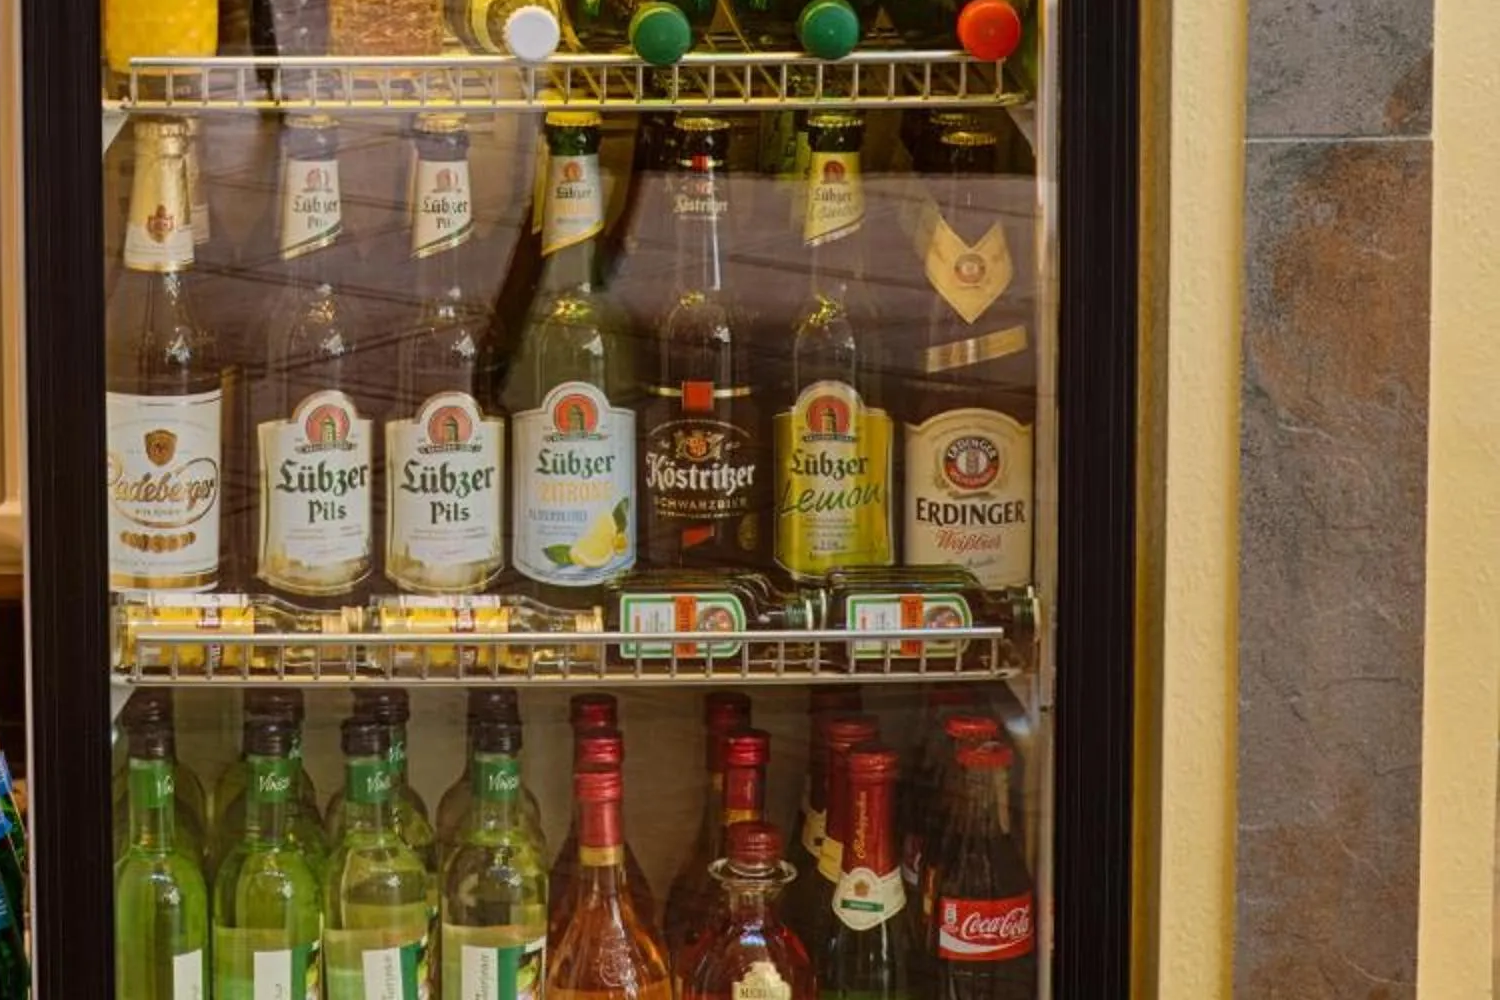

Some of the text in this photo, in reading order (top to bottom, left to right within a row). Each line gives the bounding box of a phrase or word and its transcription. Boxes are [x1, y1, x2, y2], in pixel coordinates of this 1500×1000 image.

[276, 458, 369, 496] Lübzer
[400, 458, 495, 497] Lübzer
[534, 448, 616, 479] Lübzer
[645, 451, 756, 497] Köstritzer
[789, 448, 869, 481] Lübzer
[308, 499, 348, 524] Pils
[430, 500, 471, 525] Pils
[776, 480, 882, 515] Lemon
[915, 498, 1026, 527] ERDINGER
[961, 906, 1030, 941] Coca-Cola
